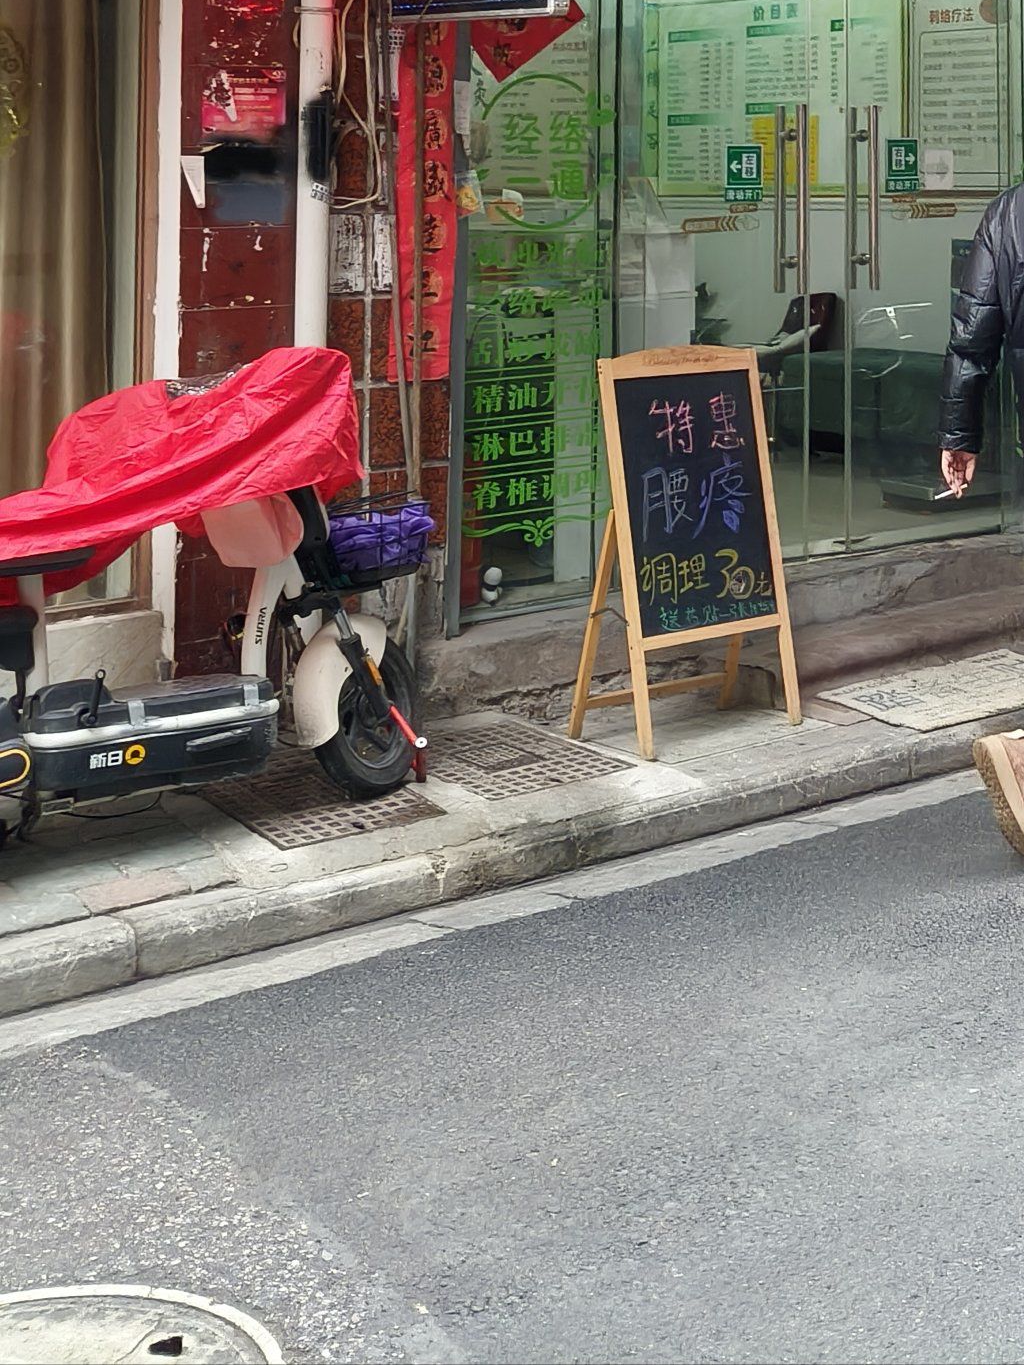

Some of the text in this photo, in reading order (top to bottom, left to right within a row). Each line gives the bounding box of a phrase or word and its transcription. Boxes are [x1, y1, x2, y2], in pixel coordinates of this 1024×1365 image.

[649, 391, 746, 454] 特惠
[641, 454, 752, 542] 腰疼
[254, 606, 268, 646] SUNRA
[89, 749, 124, 770] 新日
